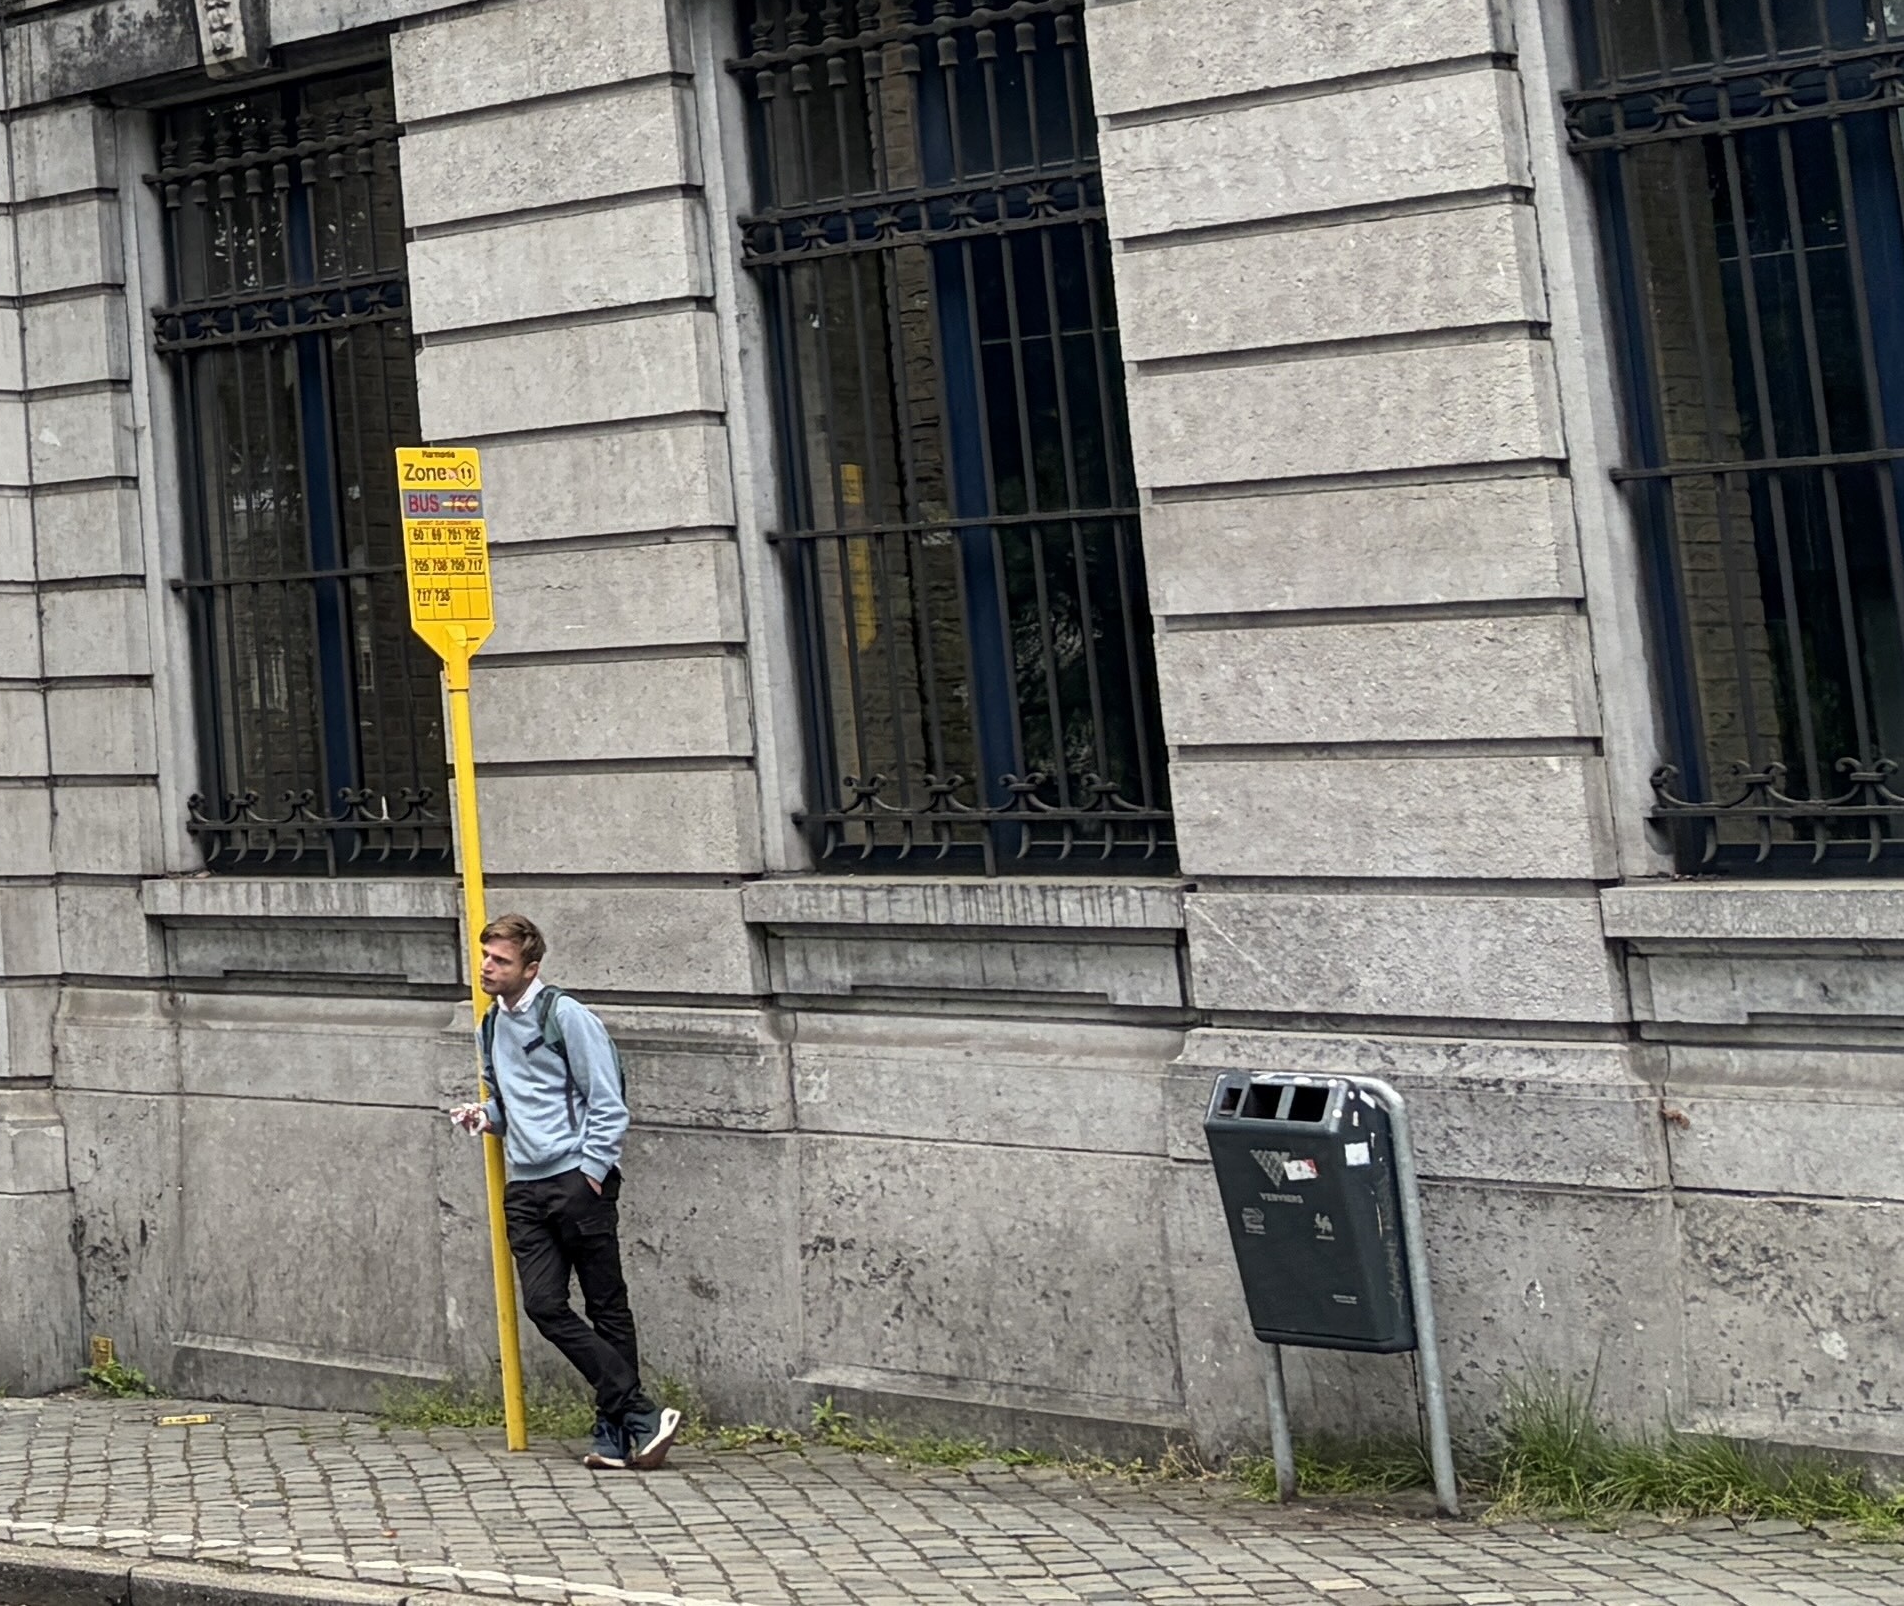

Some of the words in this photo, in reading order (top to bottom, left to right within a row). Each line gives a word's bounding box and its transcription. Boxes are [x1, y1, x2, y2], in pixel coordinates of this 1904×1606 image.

[403, 463, 448, 481] Zone
[460, 467, 473, 480] 11
[408, 493, 441, 513] BUS
